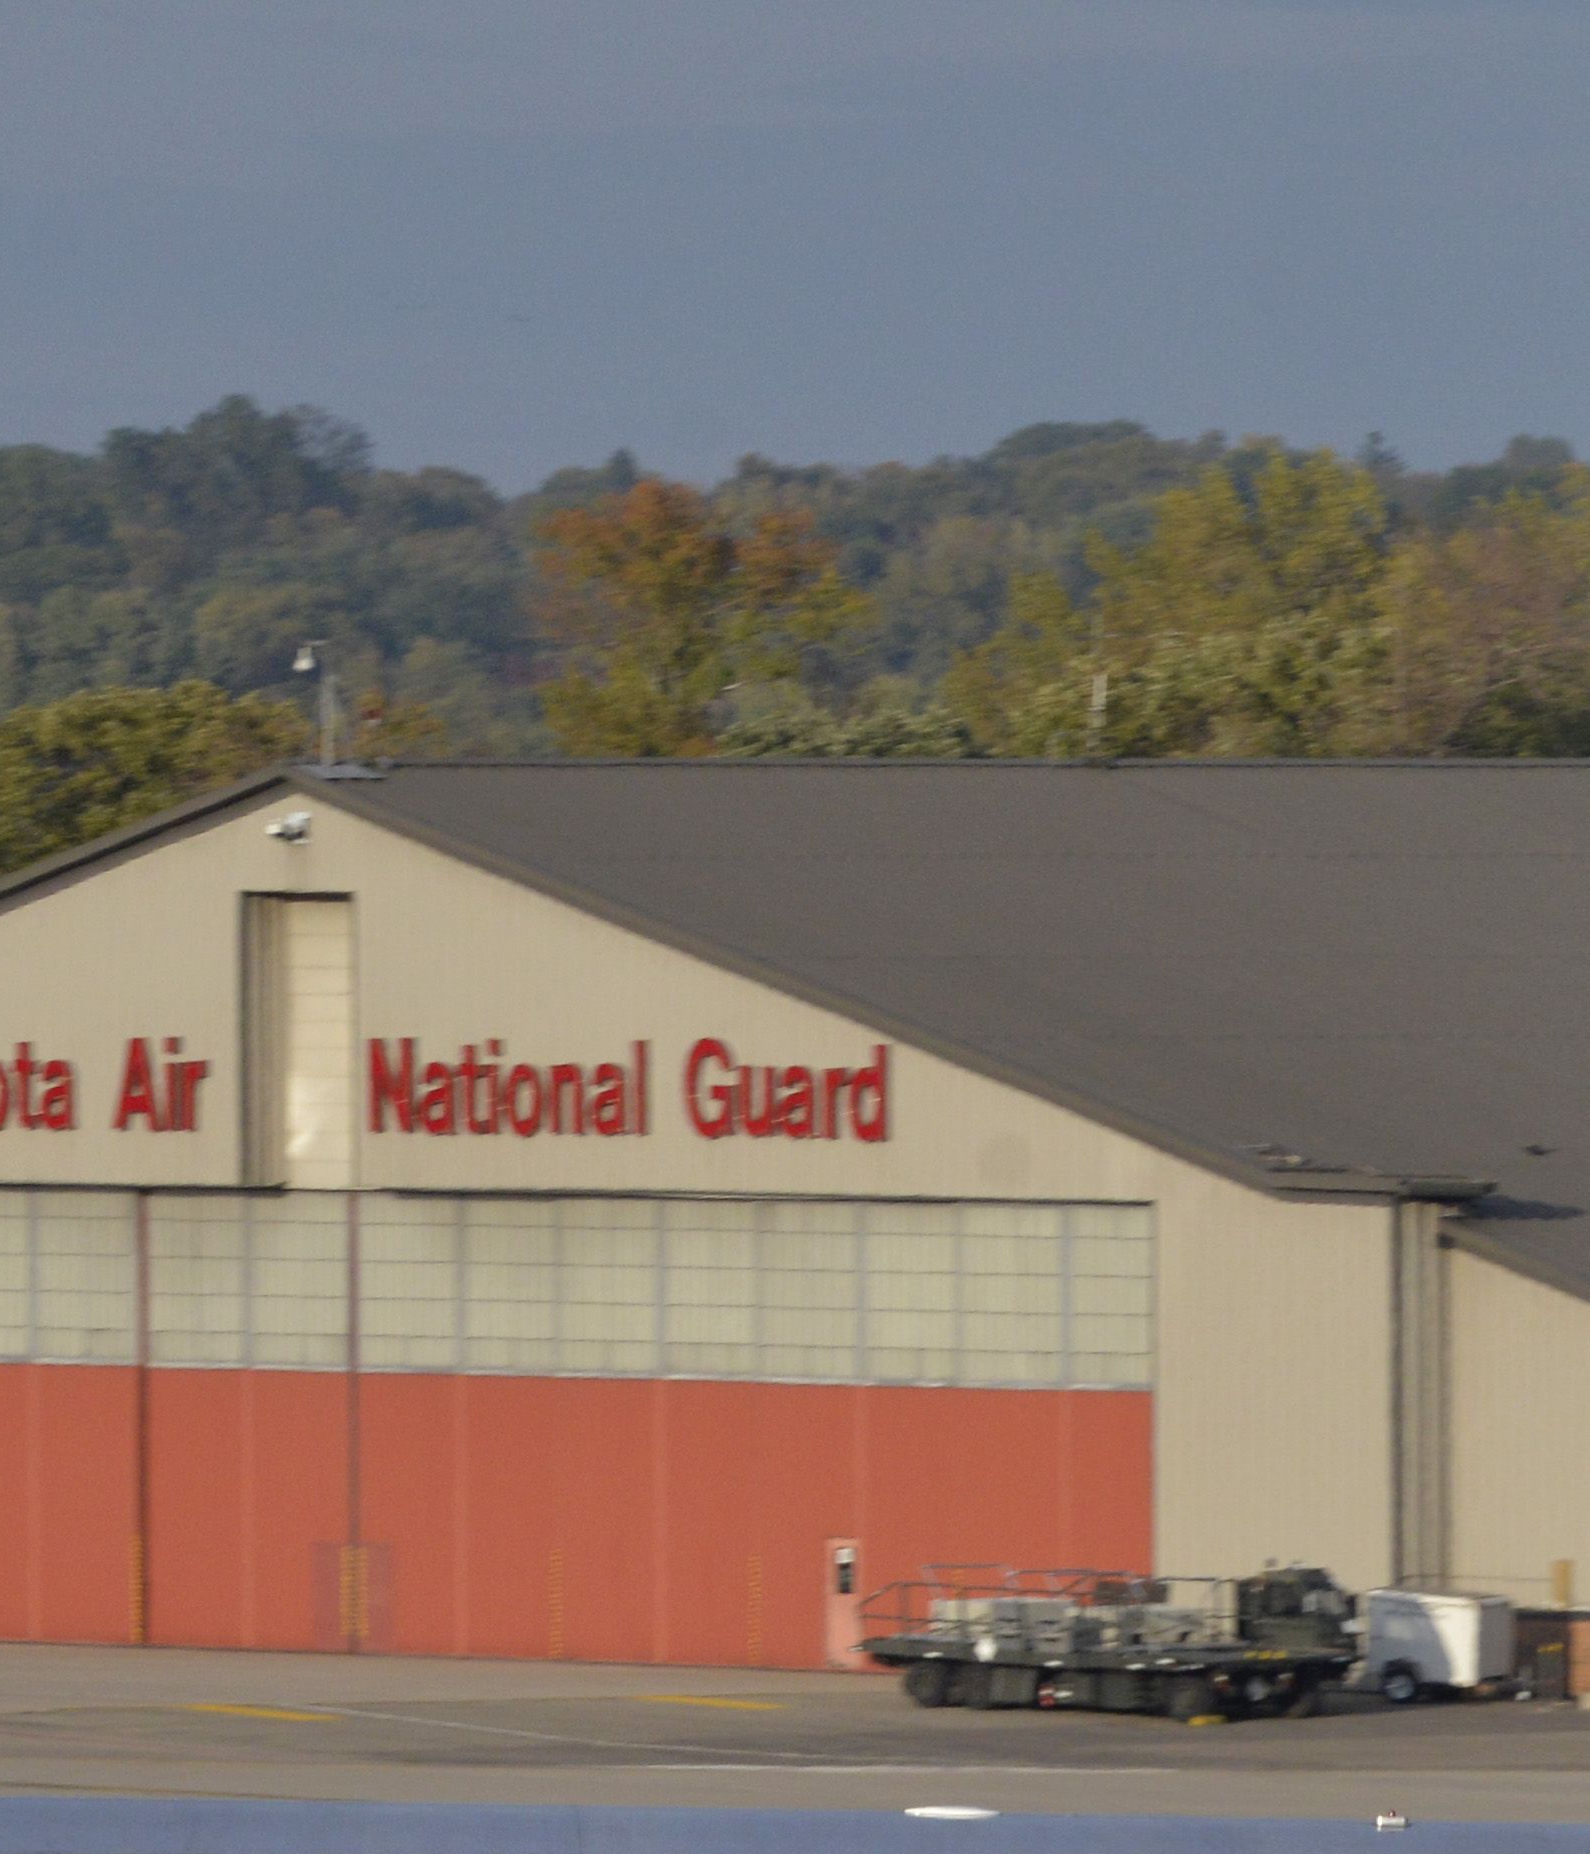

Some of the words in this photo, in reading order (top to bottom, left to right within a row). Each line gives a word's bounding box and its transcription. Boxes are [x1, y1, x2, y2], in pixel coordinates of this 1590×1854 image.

[112, 1036, 210, 1132] Air
[368, 1037, 650, 1138] National
[682, 1037, 890, 1143] Guard
